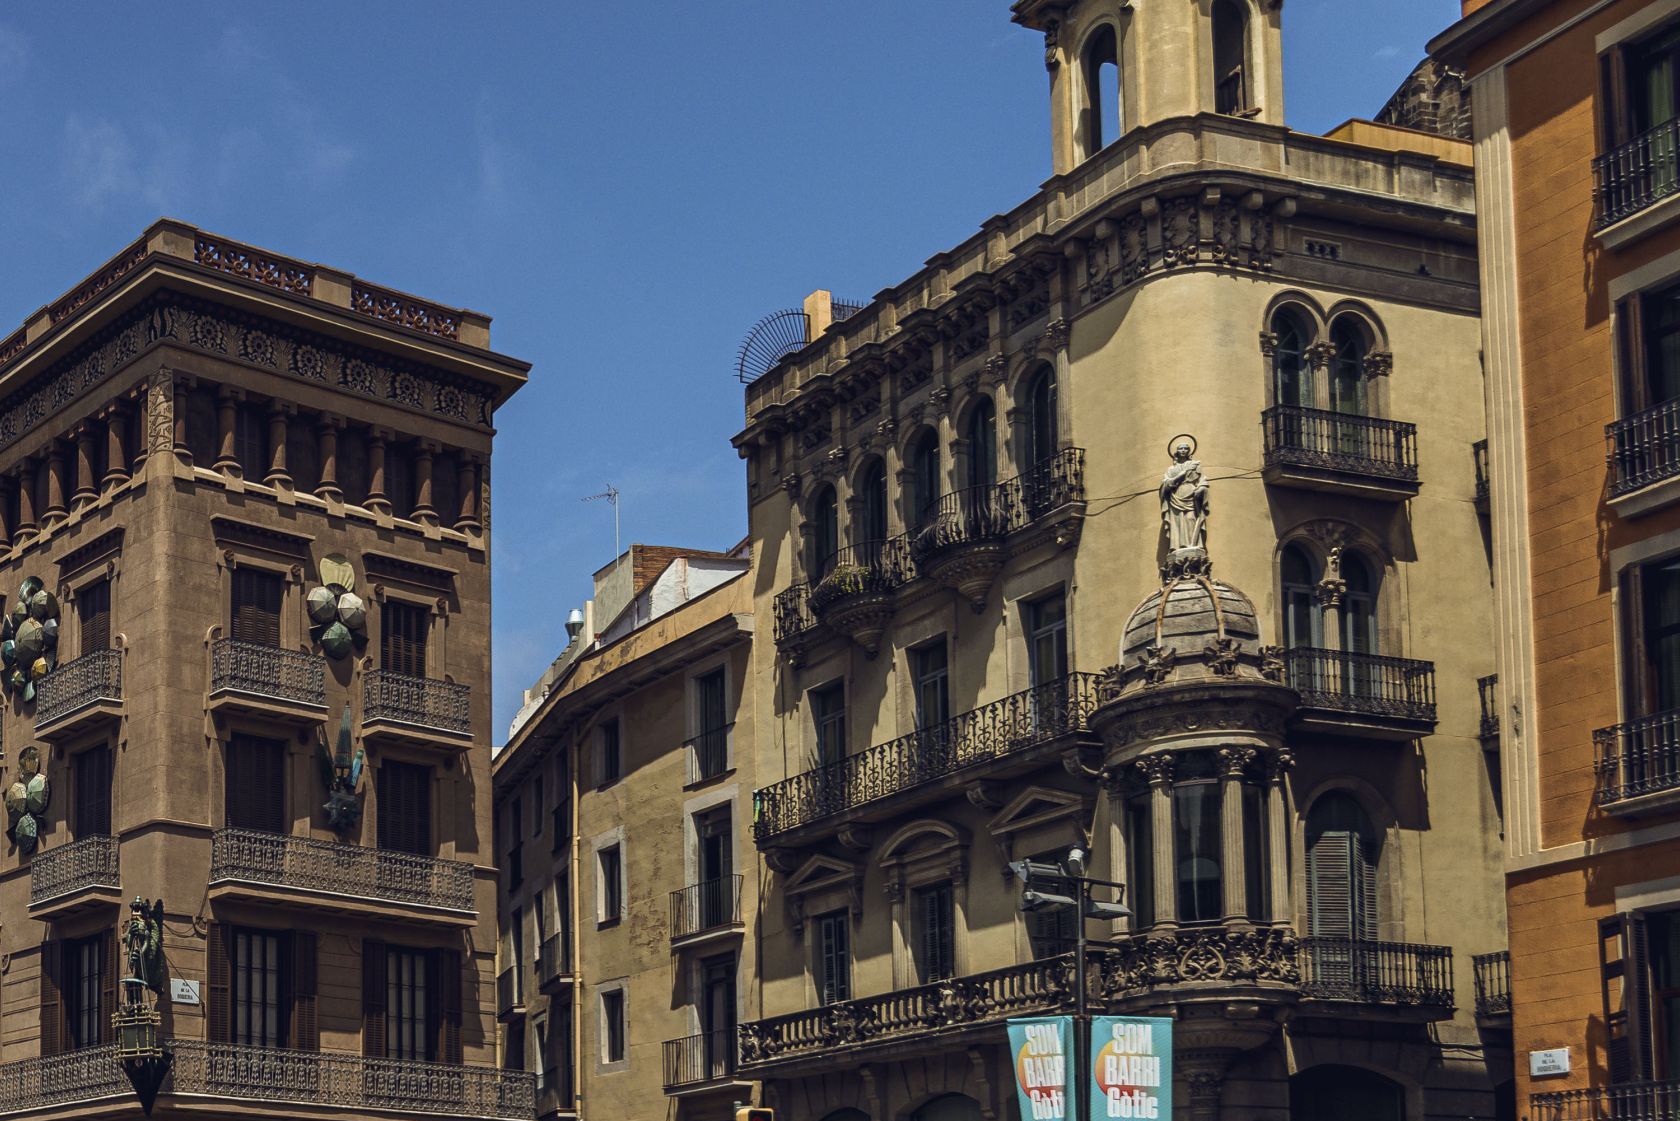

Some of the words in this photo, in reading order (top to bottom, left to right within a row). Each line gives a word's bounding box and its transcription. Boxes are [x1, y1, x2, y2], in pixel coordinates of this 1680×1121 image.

[1024, 1024, 1062, 1056] SOM
[1112, 1023, 1153, 1055] SOM
[1023, 1056, 1065, 1088] BARR
[1104, 1055, 1161, 1087] BARRI
[1107, 1087, 1158, 1119] Gòtic
